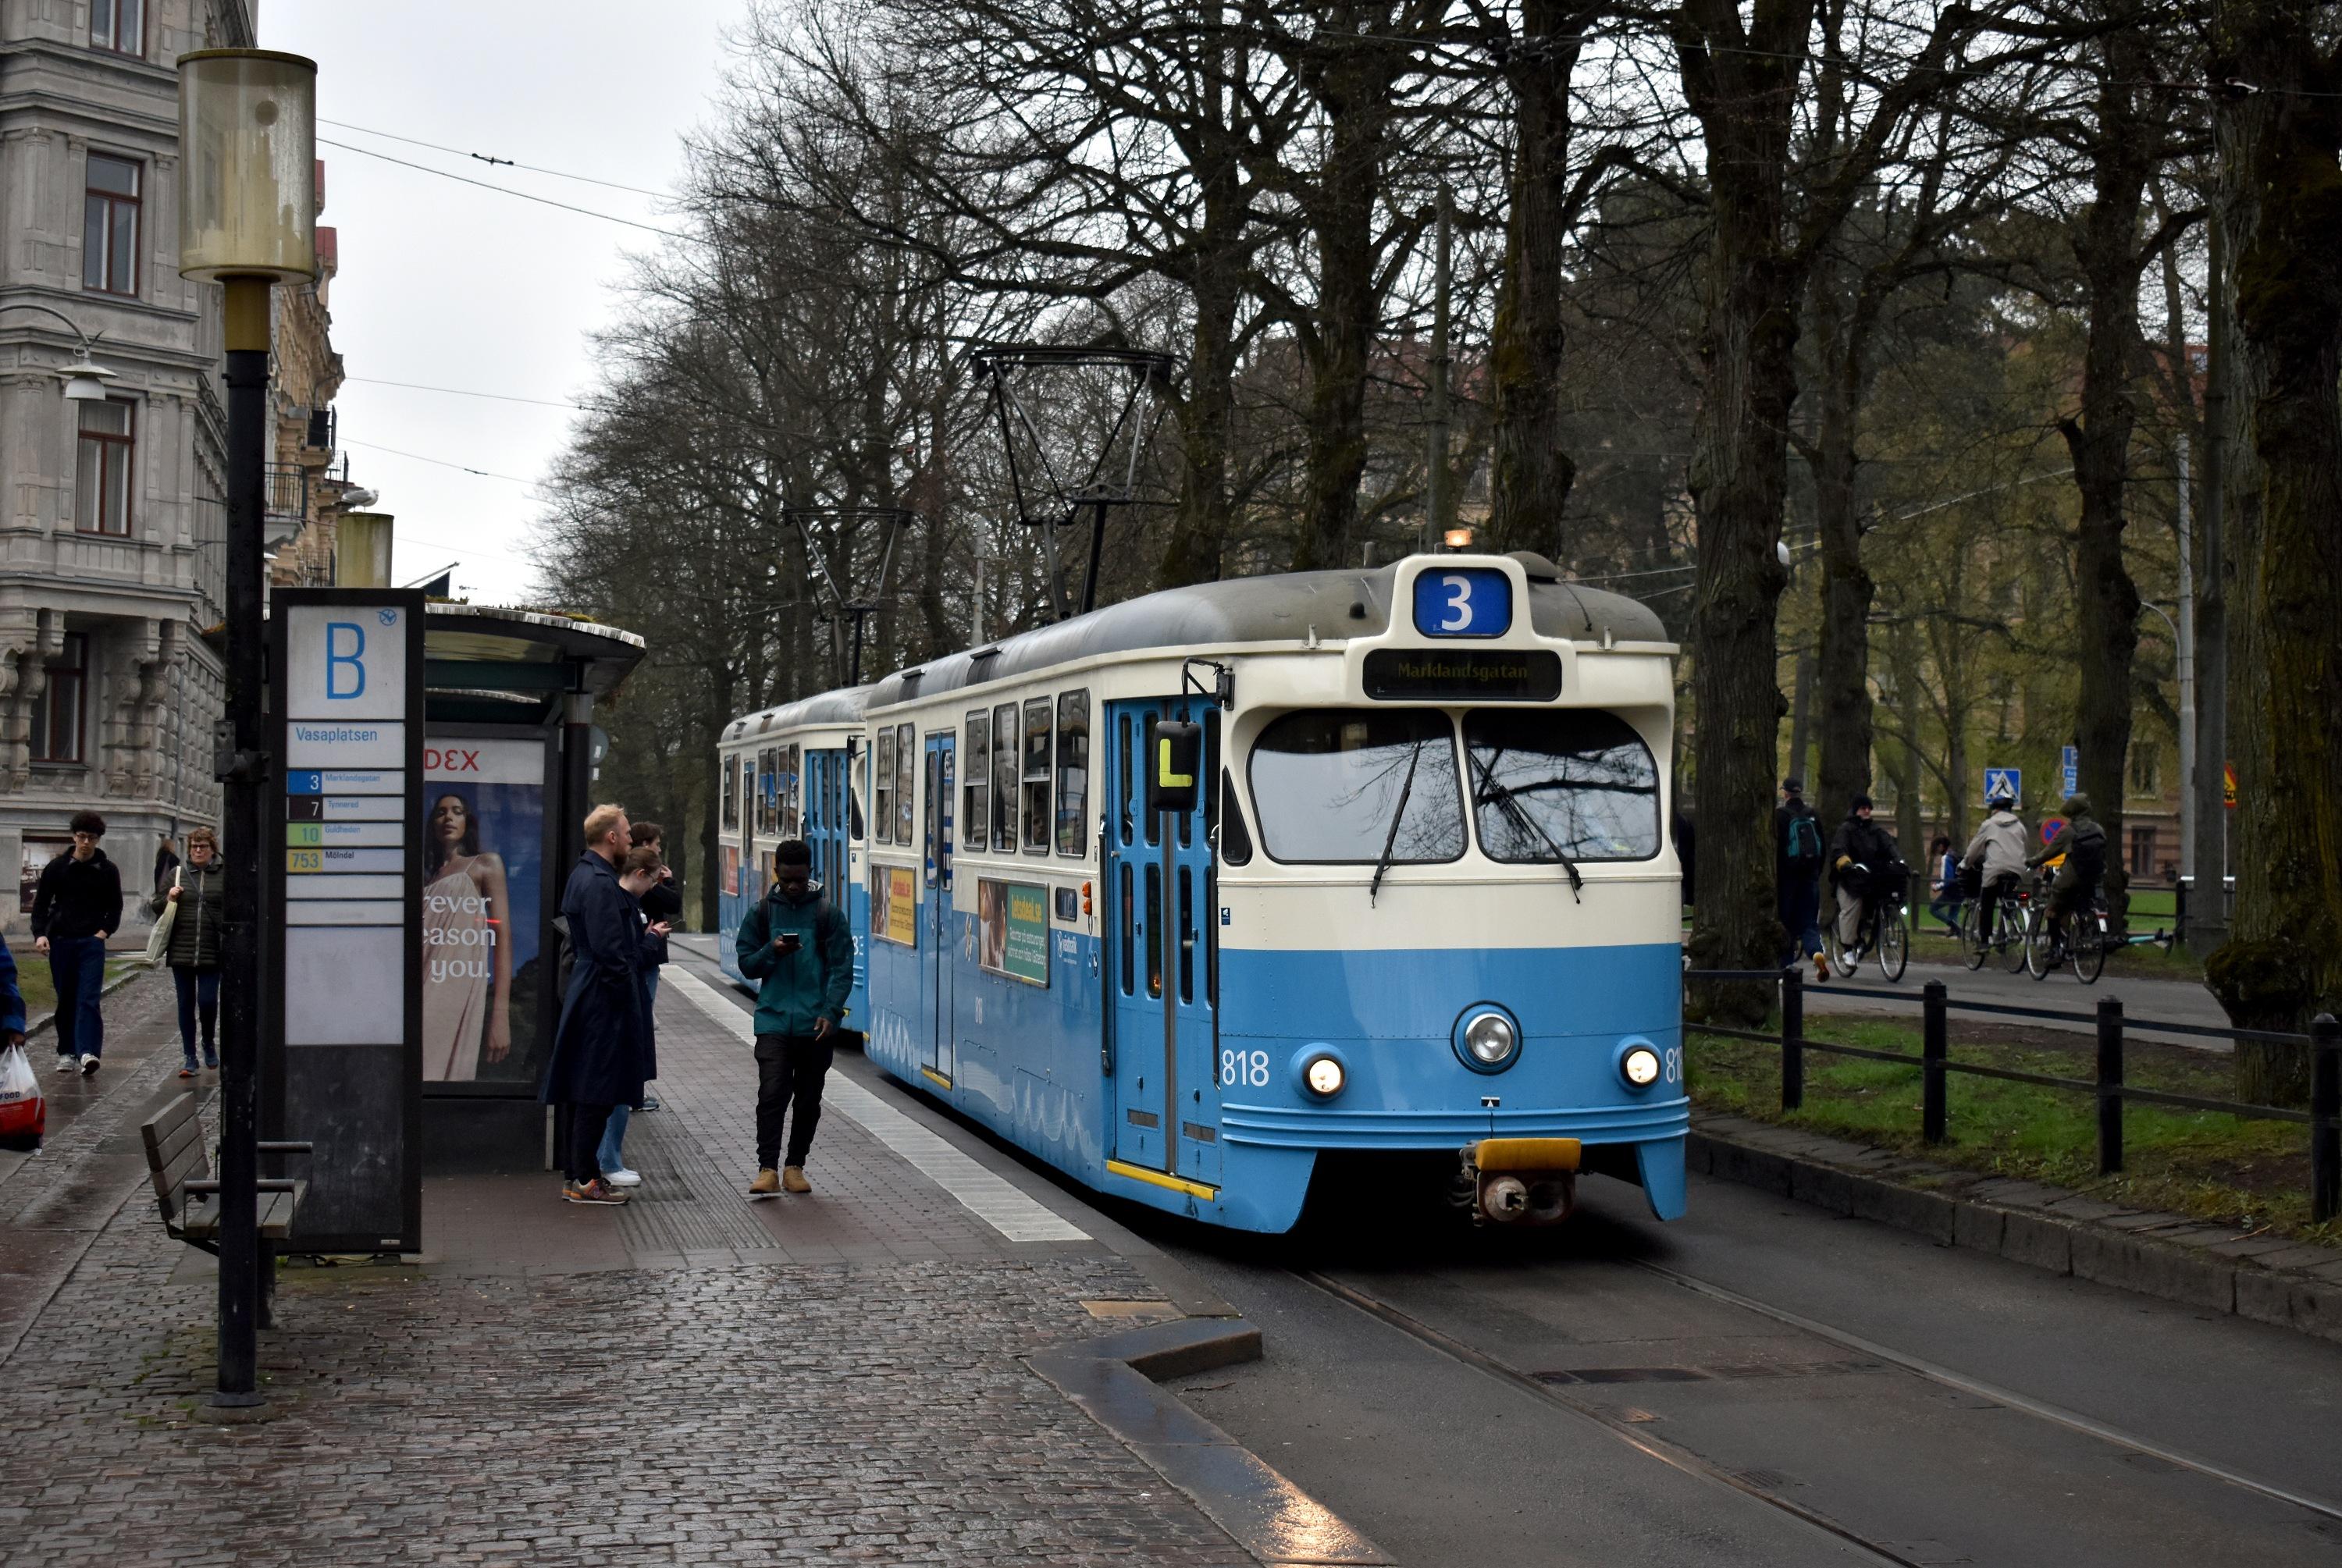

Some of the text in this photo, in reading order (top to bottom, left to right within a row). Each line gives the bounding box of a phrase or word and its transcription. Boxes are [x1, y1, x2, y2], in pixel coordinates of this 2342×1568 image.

[1441, 575, 1472, 631] 3
[326, 622, 366, 699] B
[1398, 662, 1528, 681] Marklandsgatan
[296, 726, 378, 743] Vasaplatsen
[310, 773, 380, 790] 3 Marklandsgatan
[311, 800, 359, 816] 7 Tynnered
[302, 827, 319, 842] 10
[292, 853, 319, 868] 753
[431, 960, 491, 983] you.
[1223, 1049, 1269, 1086] 818
